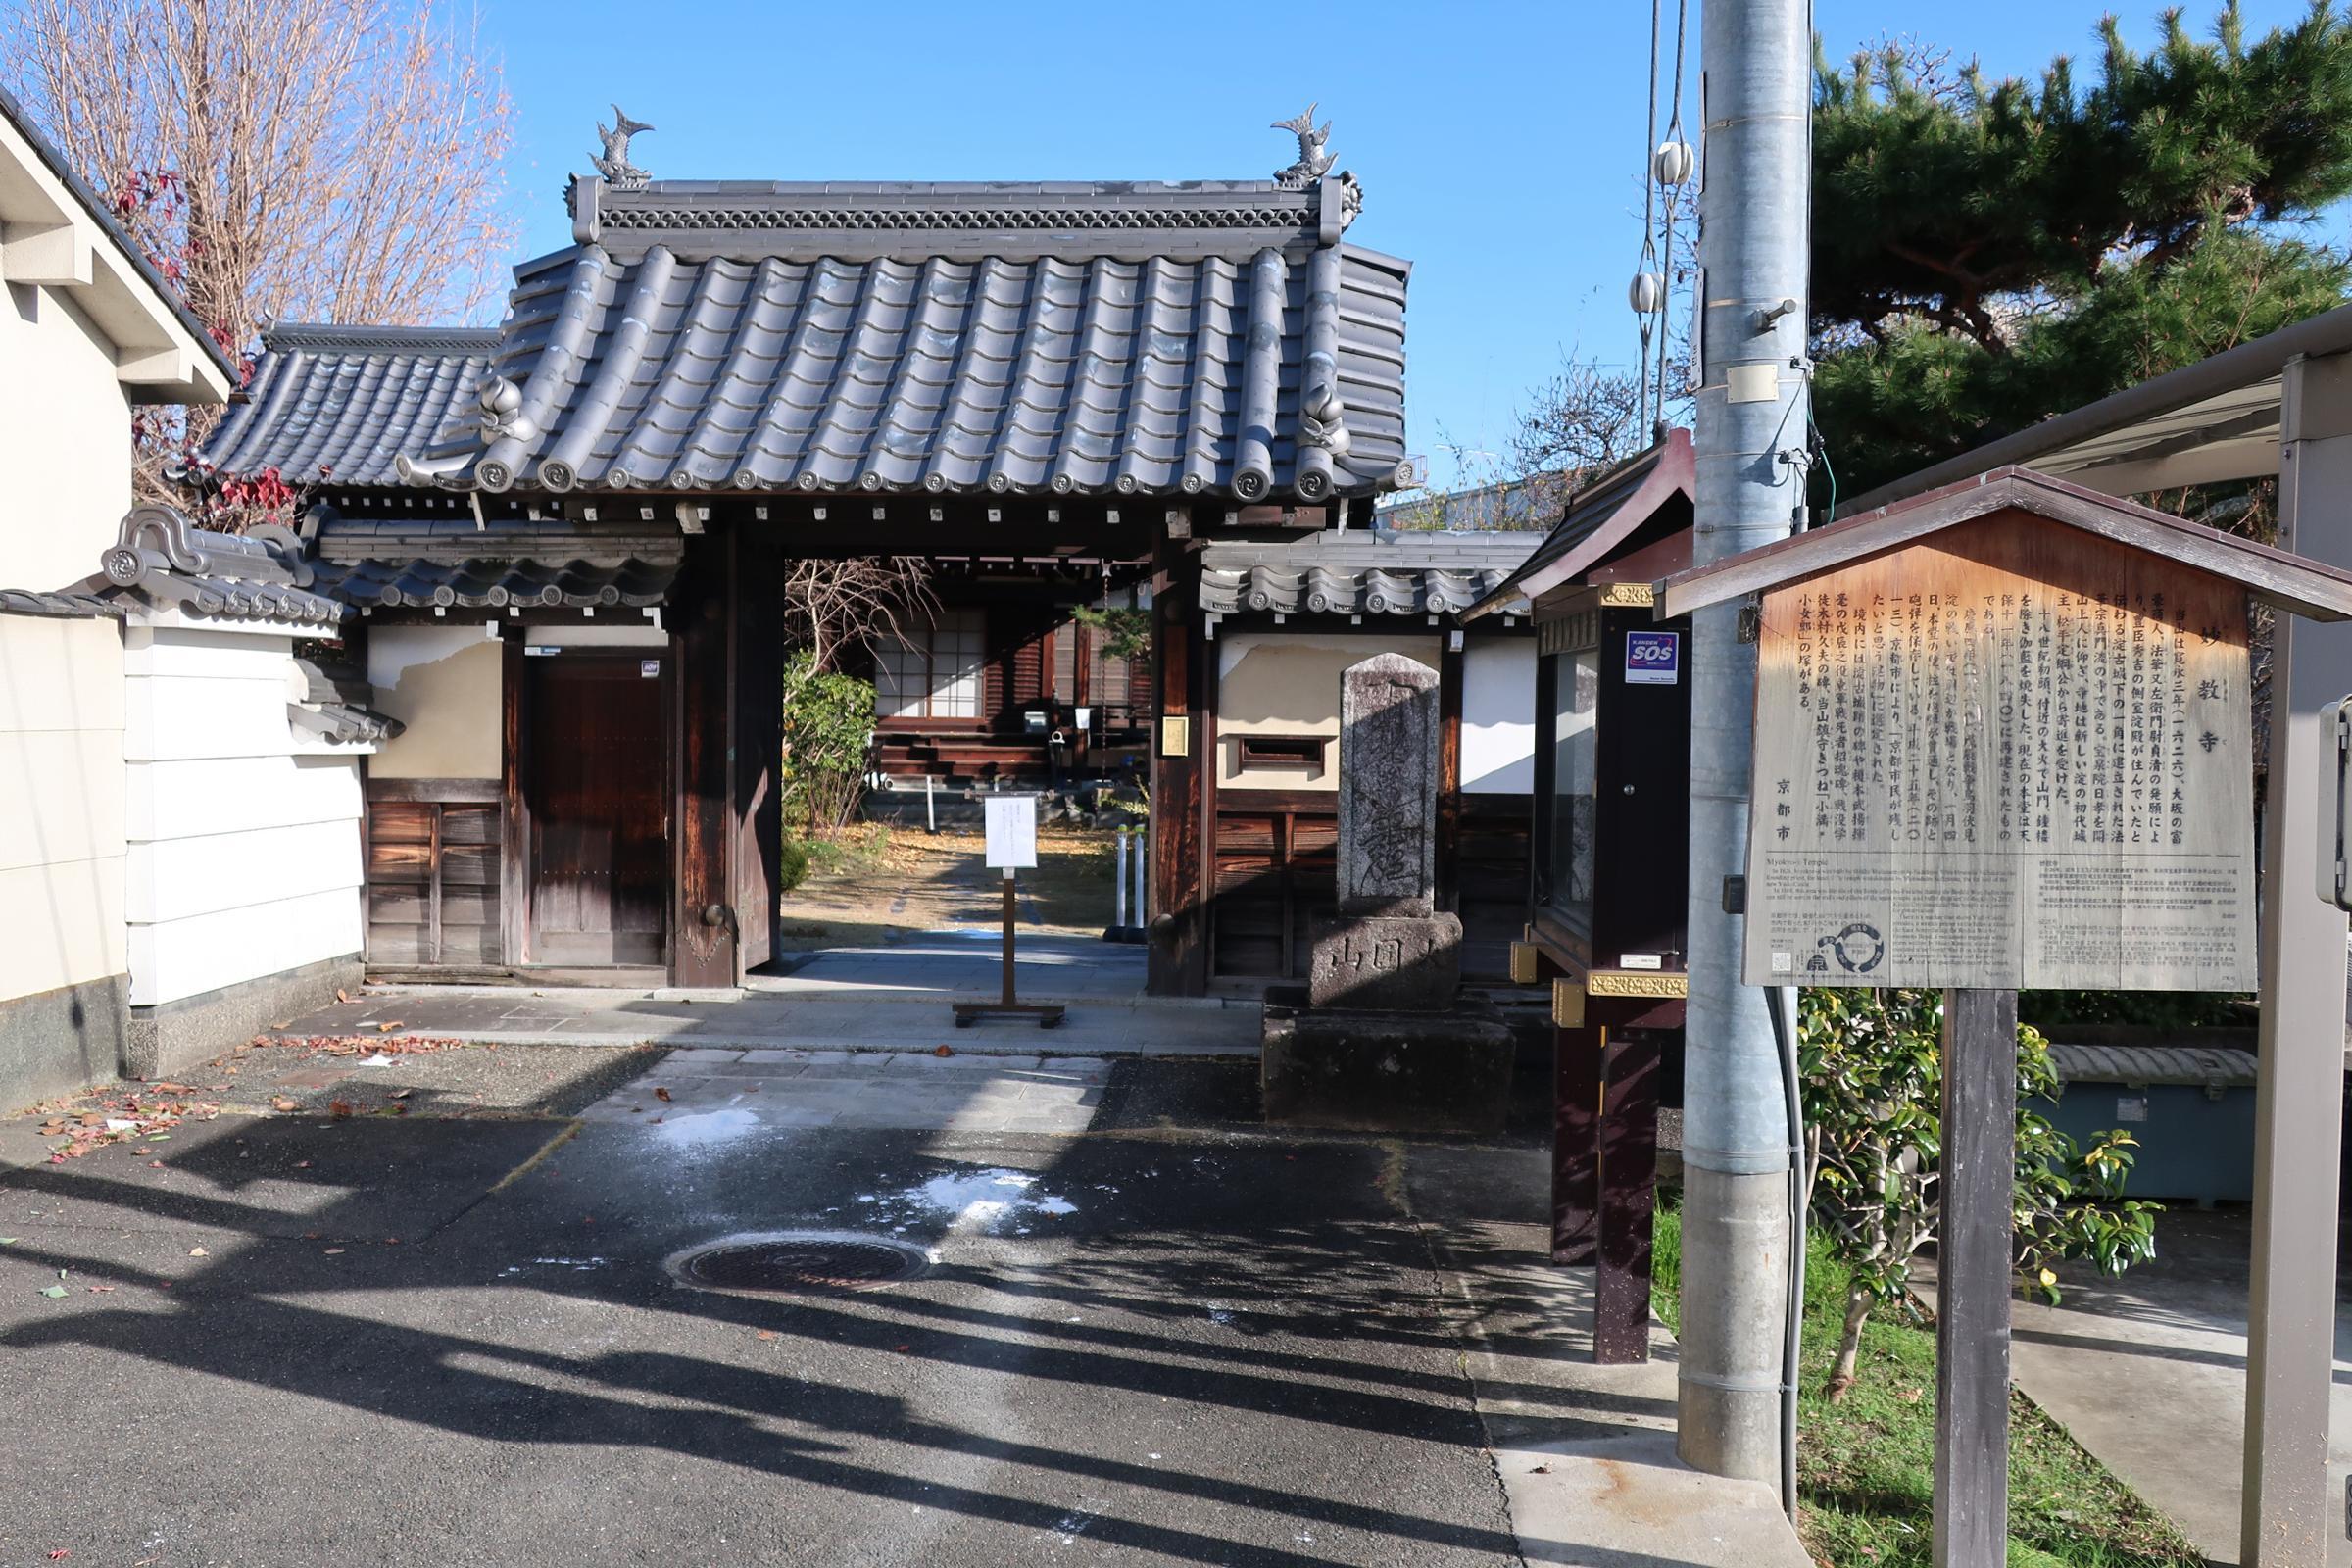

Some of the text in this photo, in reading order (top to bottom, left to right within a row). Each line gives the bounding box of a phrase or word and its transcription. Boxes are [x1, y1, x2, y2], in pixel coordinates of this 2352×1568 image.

[1632, 645, 1673, 661] SOS
[1775, 778, 1791, 842] 京都市
